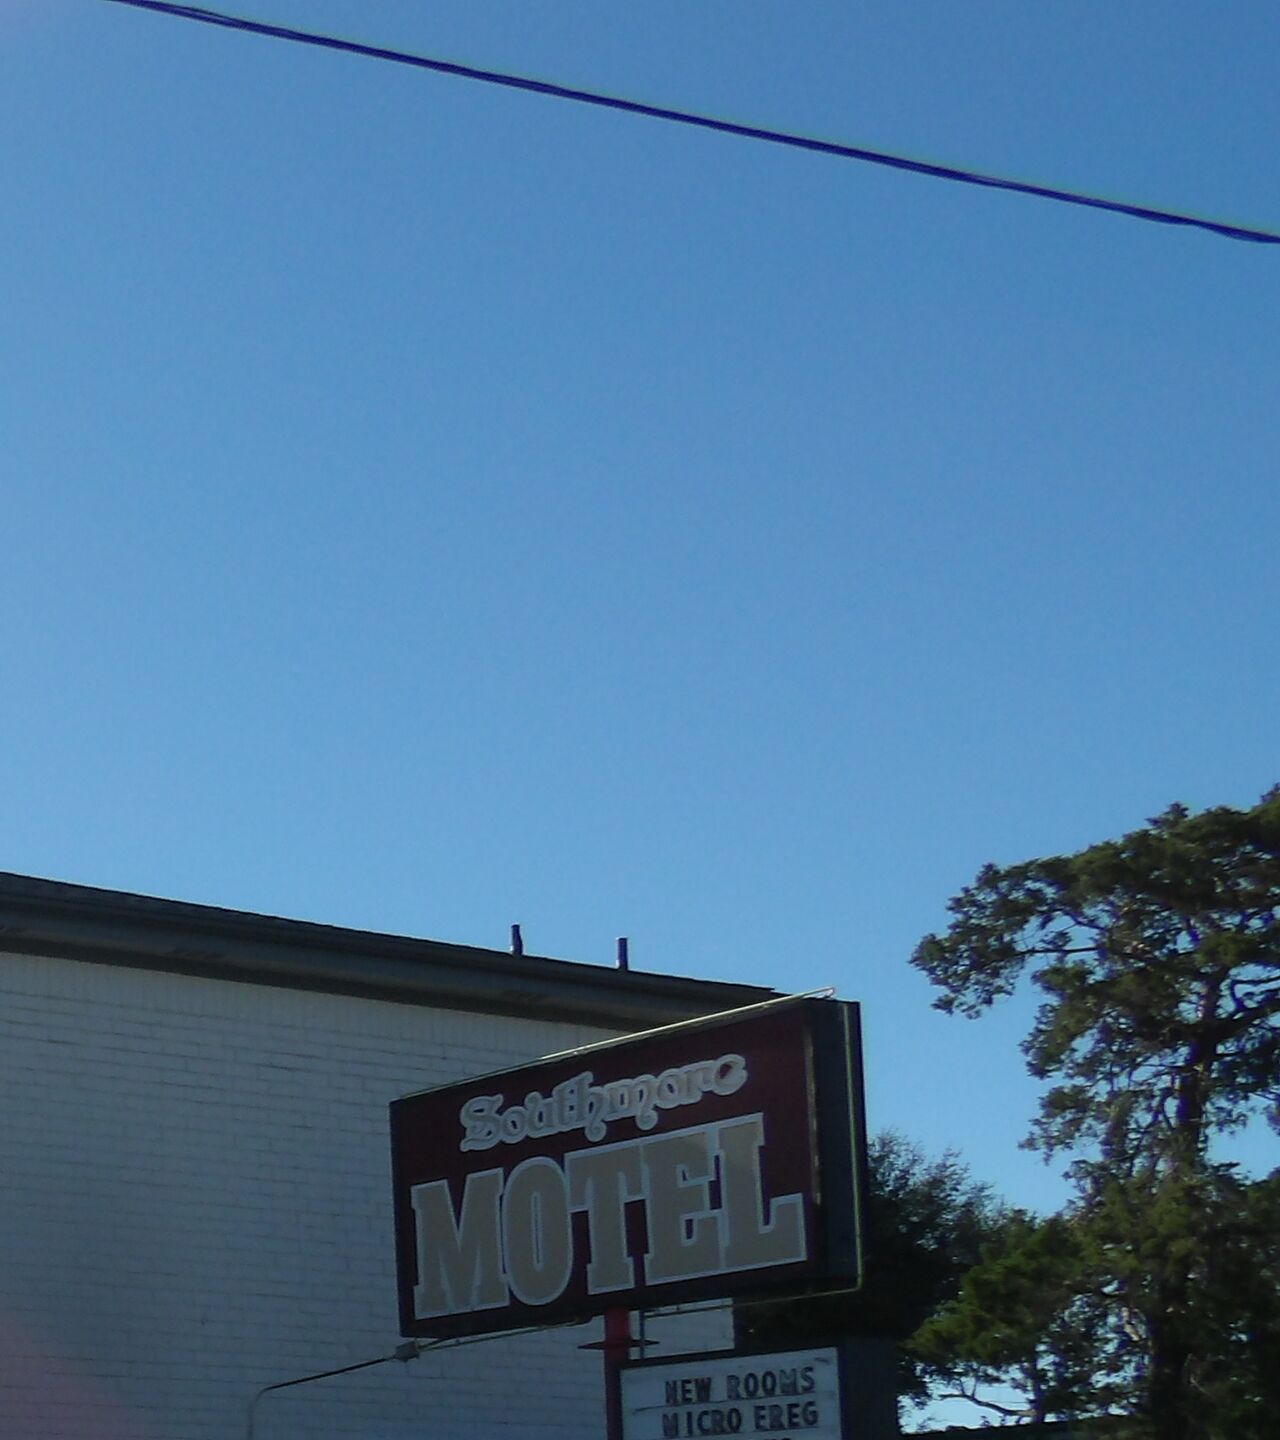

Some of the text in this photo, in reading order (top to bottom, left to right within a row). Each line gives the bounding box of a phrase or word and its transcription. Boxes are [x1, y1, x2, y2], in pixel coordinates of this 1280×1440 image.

[459, 1053, 748, 1154] Southmore
[410, 1112, 807, 1320] MOTEL
[664, 1366, 816, 1406] NEW ROOMS
[662, 1407, 742, 1439] MICRO
